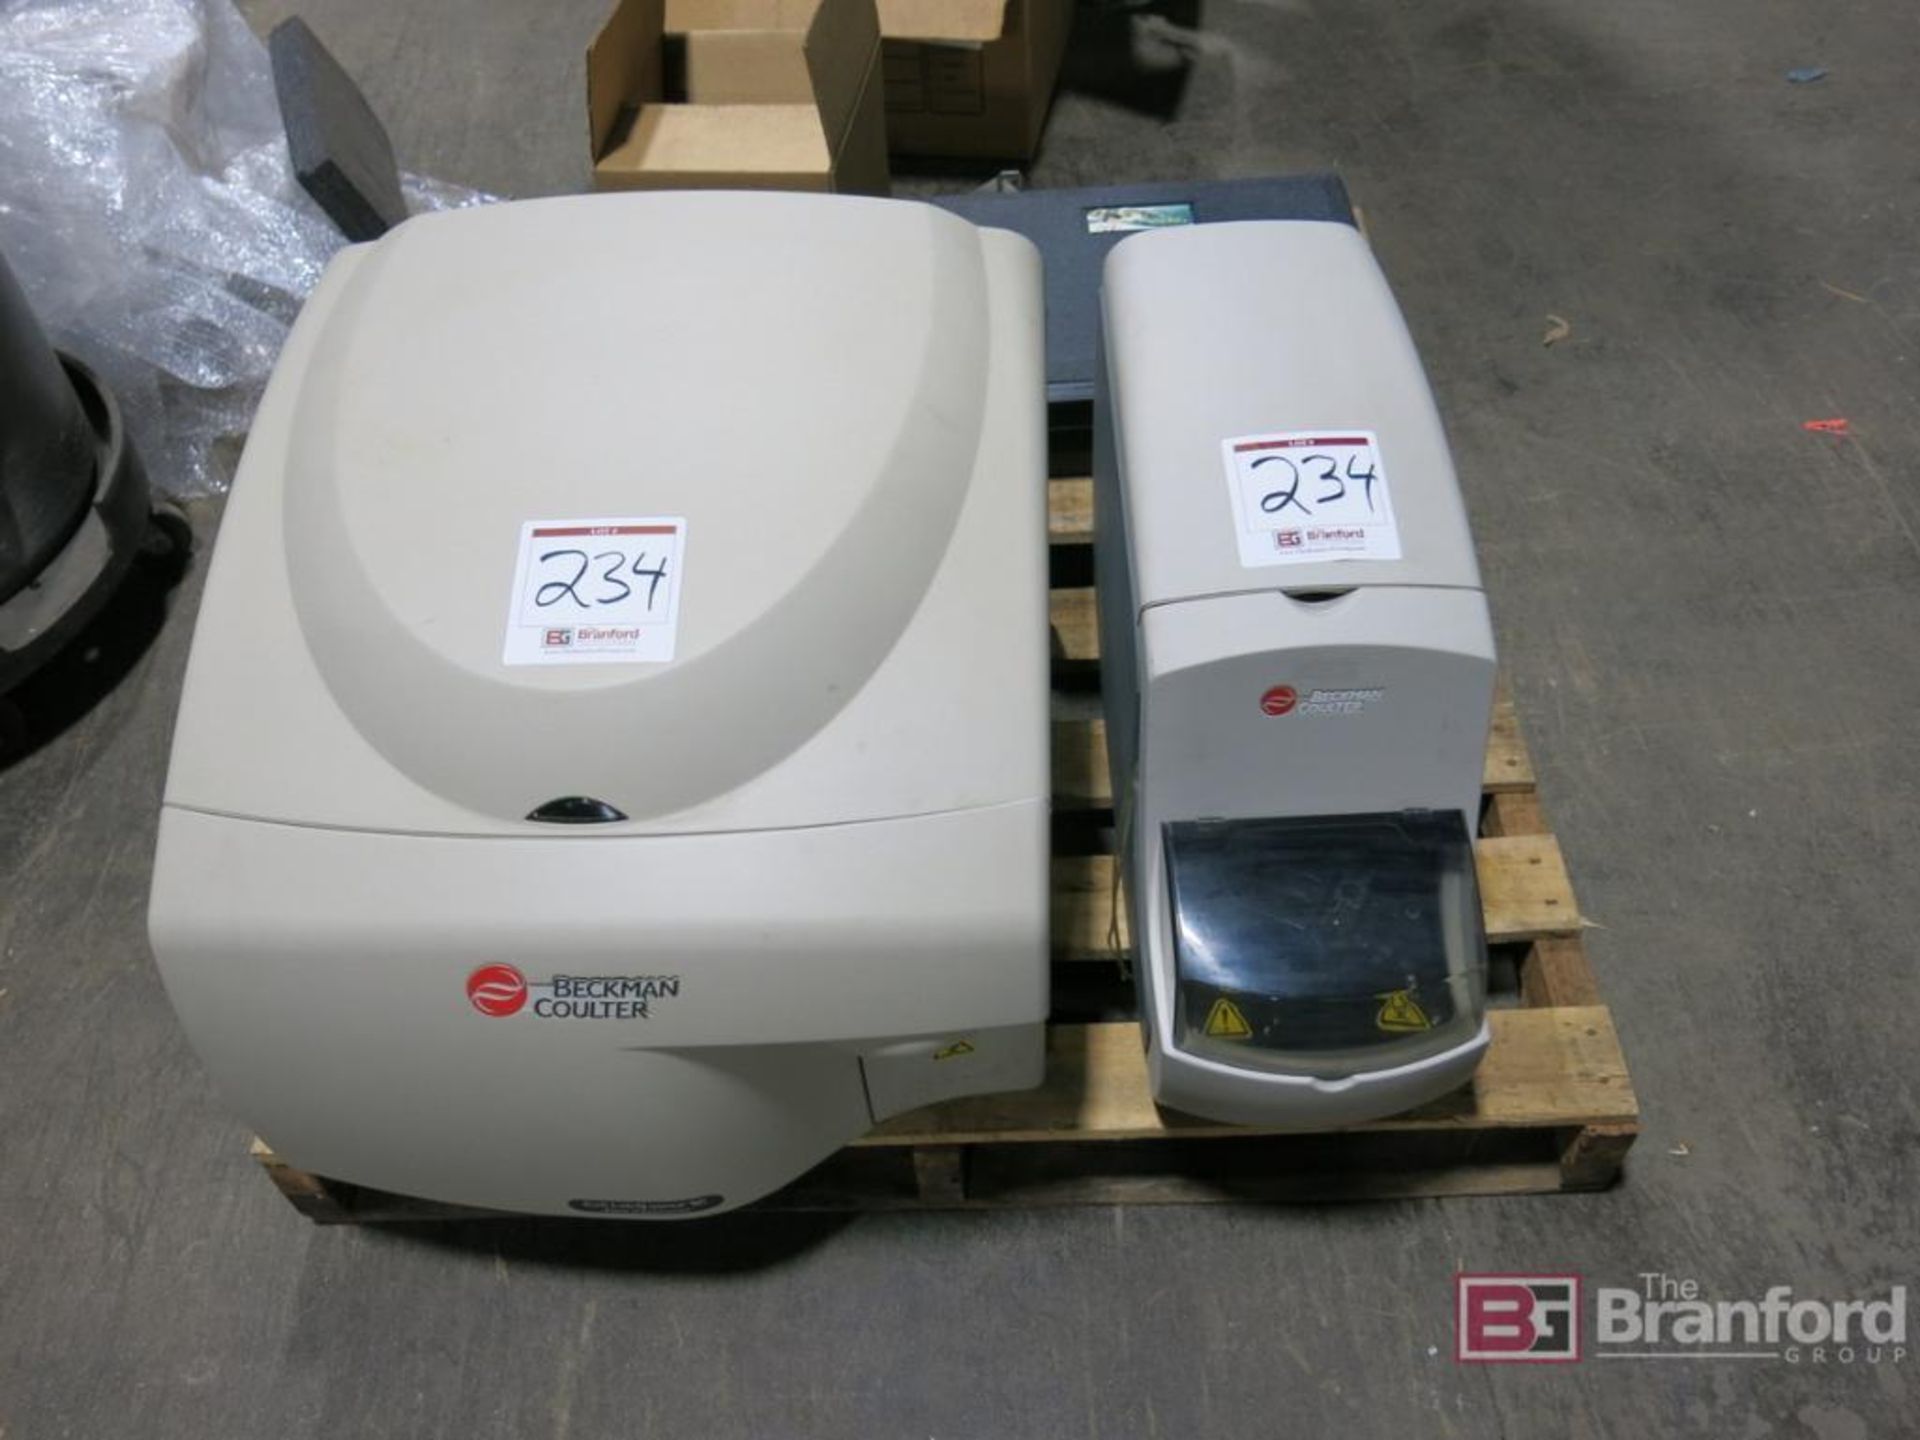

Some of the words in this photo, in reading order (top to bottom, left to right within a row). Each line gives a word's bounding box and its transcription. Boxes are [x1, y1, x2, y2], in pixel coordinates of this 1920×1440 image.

[1250, 454, 1378, 515] 234
[534, 549, 668, 612] 234
[577, 628, 641, 640] Branford
[552, 976, 680, 999] BECKMAN
[533, 998, 649, 1019] COULTER
